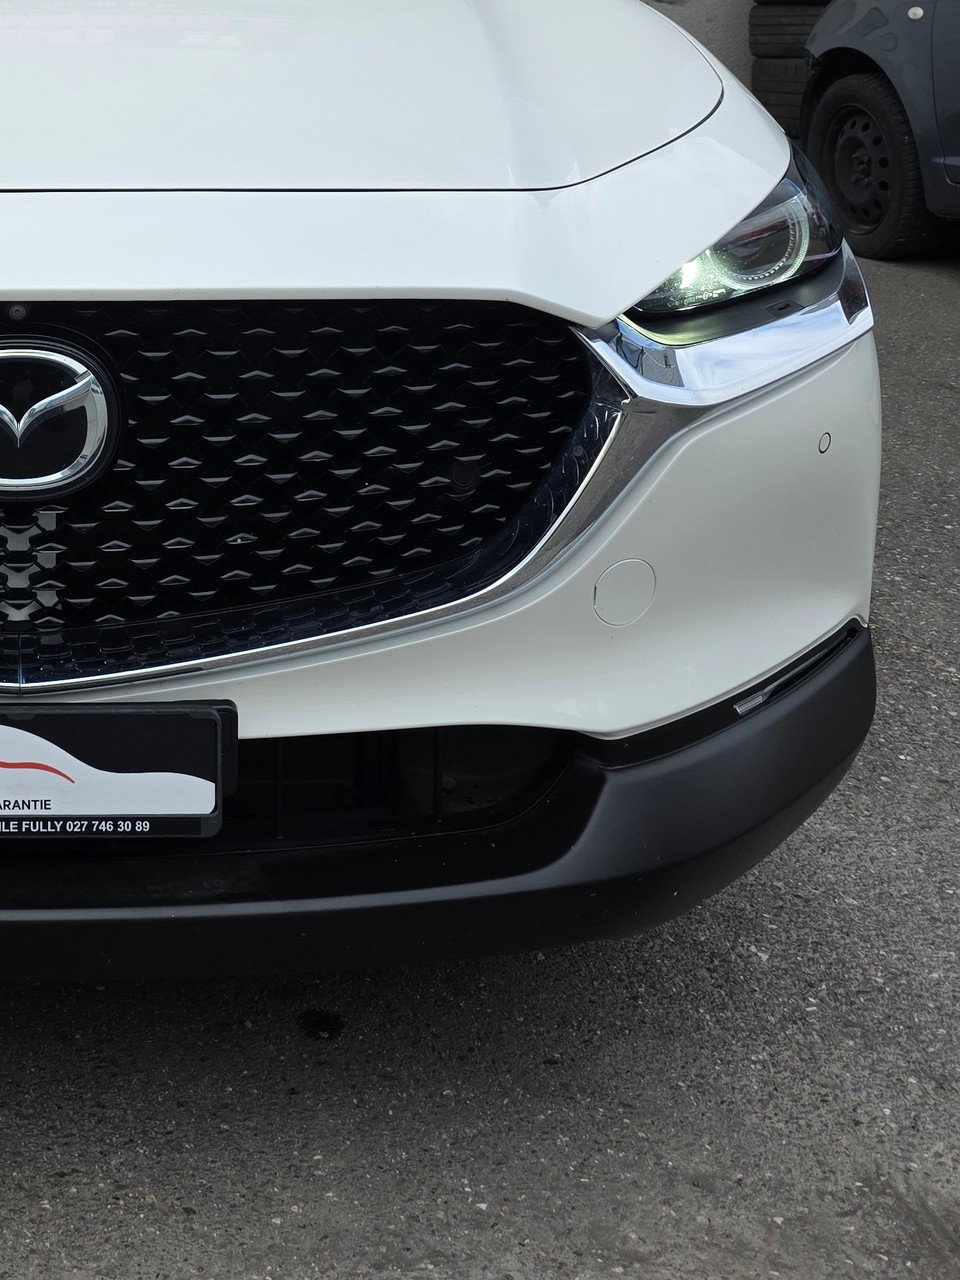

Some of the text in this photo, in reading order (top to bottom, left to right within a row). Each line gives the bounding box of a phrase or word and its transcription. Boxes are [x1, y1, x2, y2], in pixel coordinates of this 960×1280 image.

[22, 821, 63, 832] FULLY
[66, 821, 88, 832] 027
[92, 821, 113, 832] 746
[117, 821, 131, 832] 30
[135, 821, 150, 832] 89
